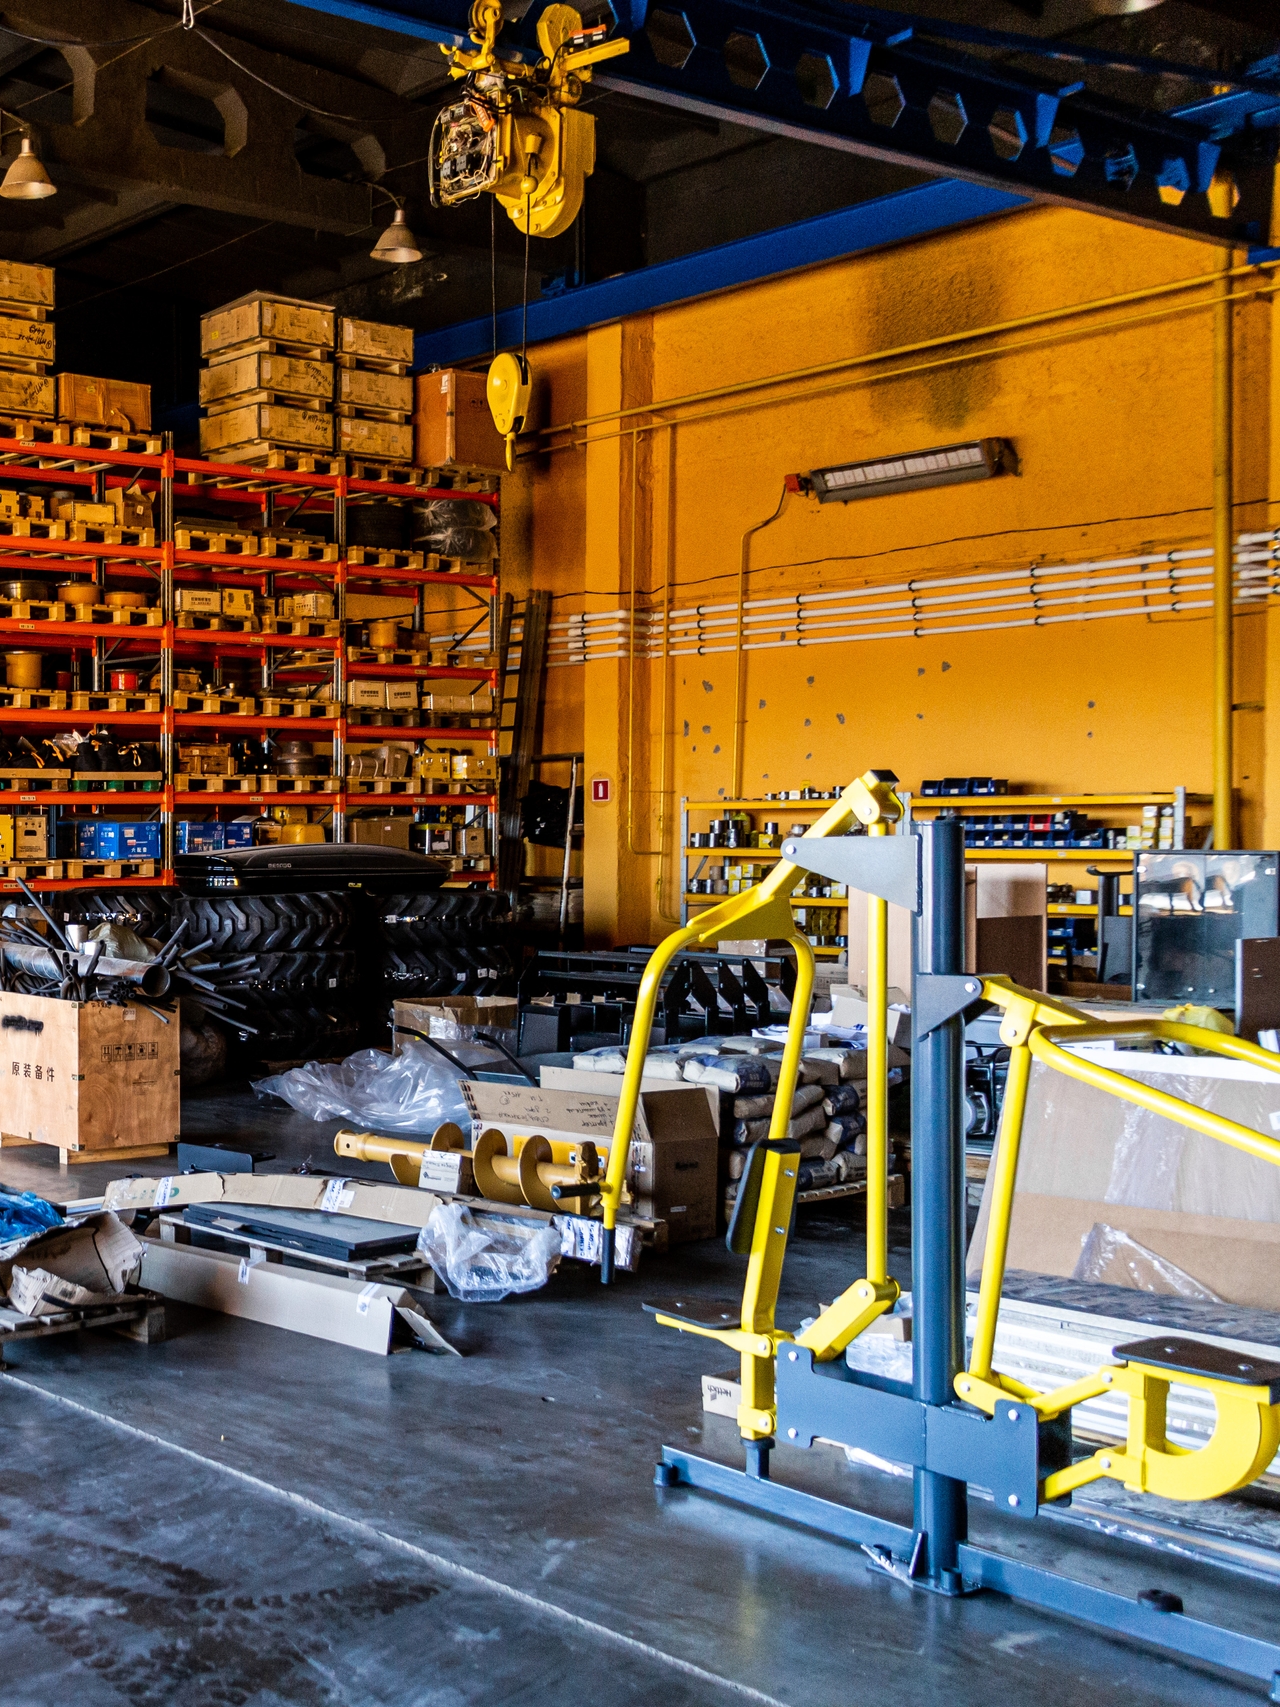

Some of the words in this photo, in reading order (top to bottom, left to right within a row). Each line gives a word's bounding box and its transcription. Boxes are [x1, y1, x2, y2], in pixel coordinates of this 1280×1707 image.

[11, 1061, 55, 1082] 原装备件
[707, 1384, 732, 1398] Hettich
